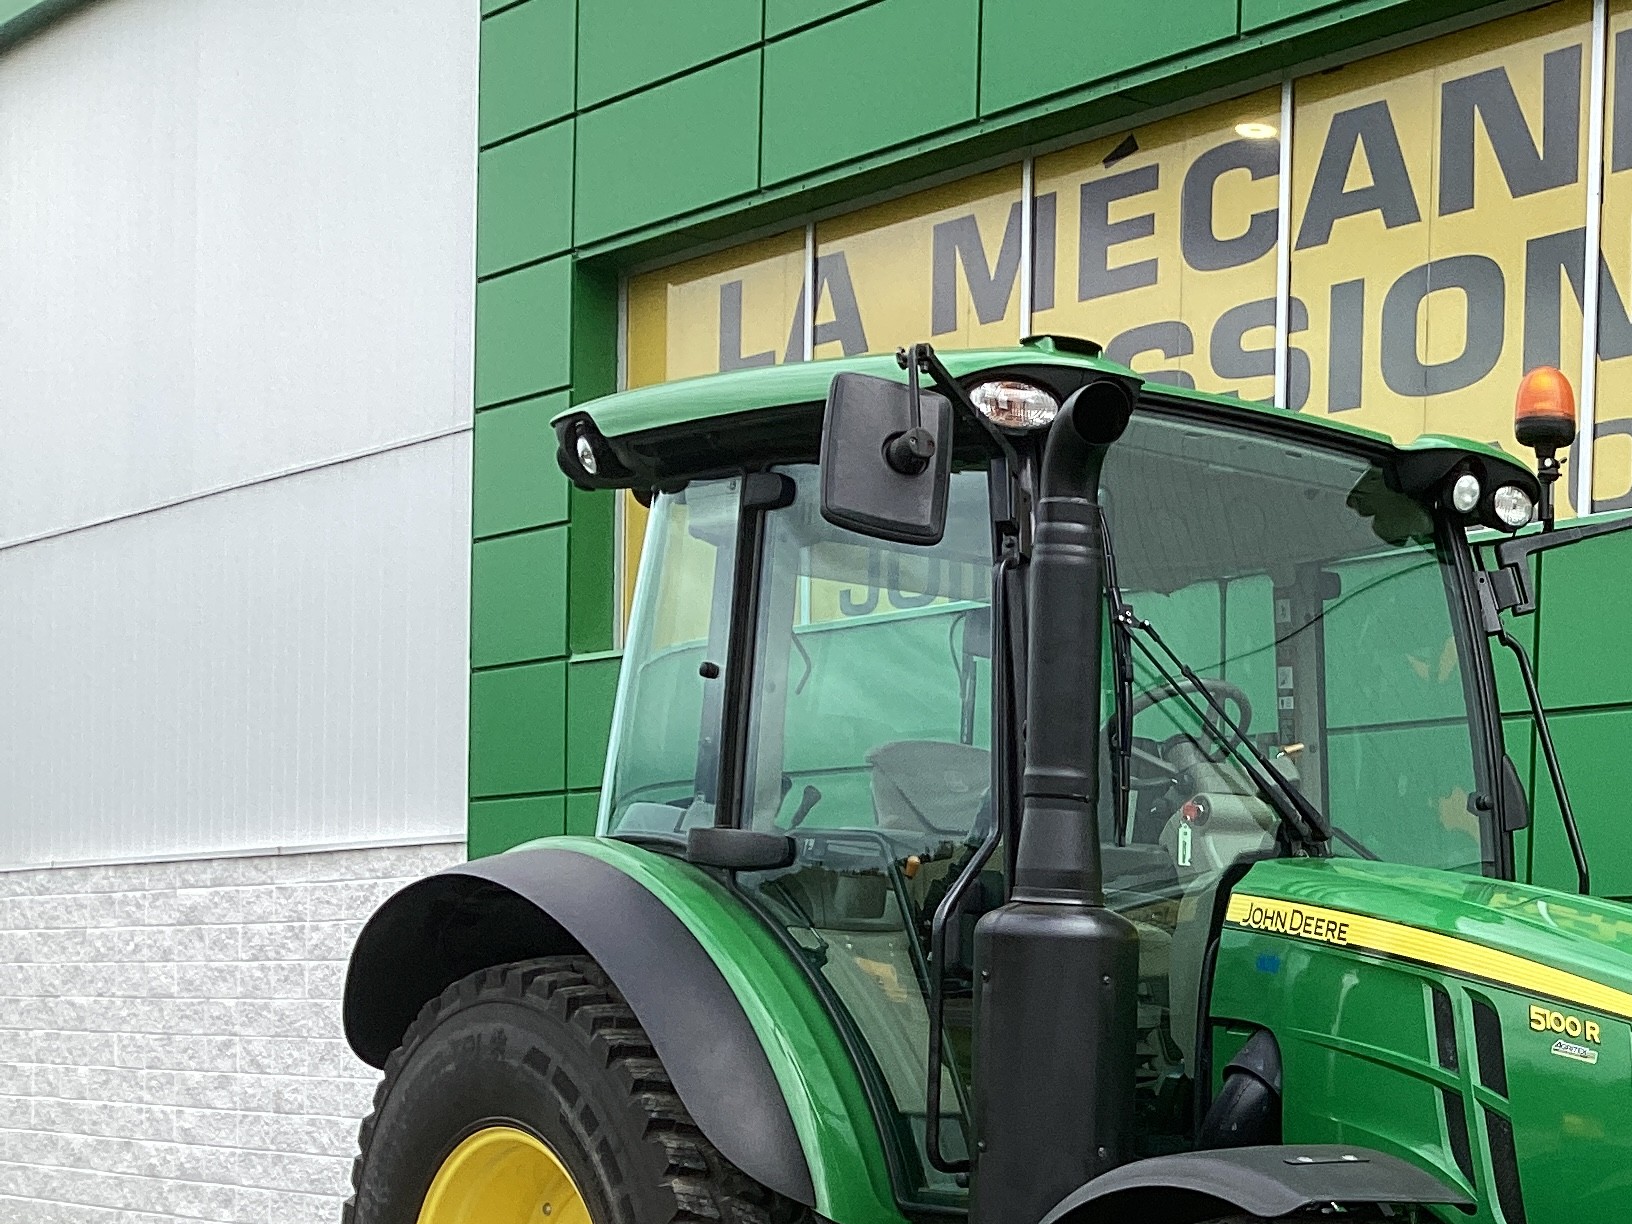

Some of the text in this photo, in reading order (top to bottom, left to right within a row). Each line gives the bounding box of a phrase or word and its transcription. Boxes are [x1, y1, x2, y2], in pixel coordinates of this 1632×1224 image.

[718, 251, 869, 372] LA
[1242, 902, 1350, 942] JOHN DEERE
